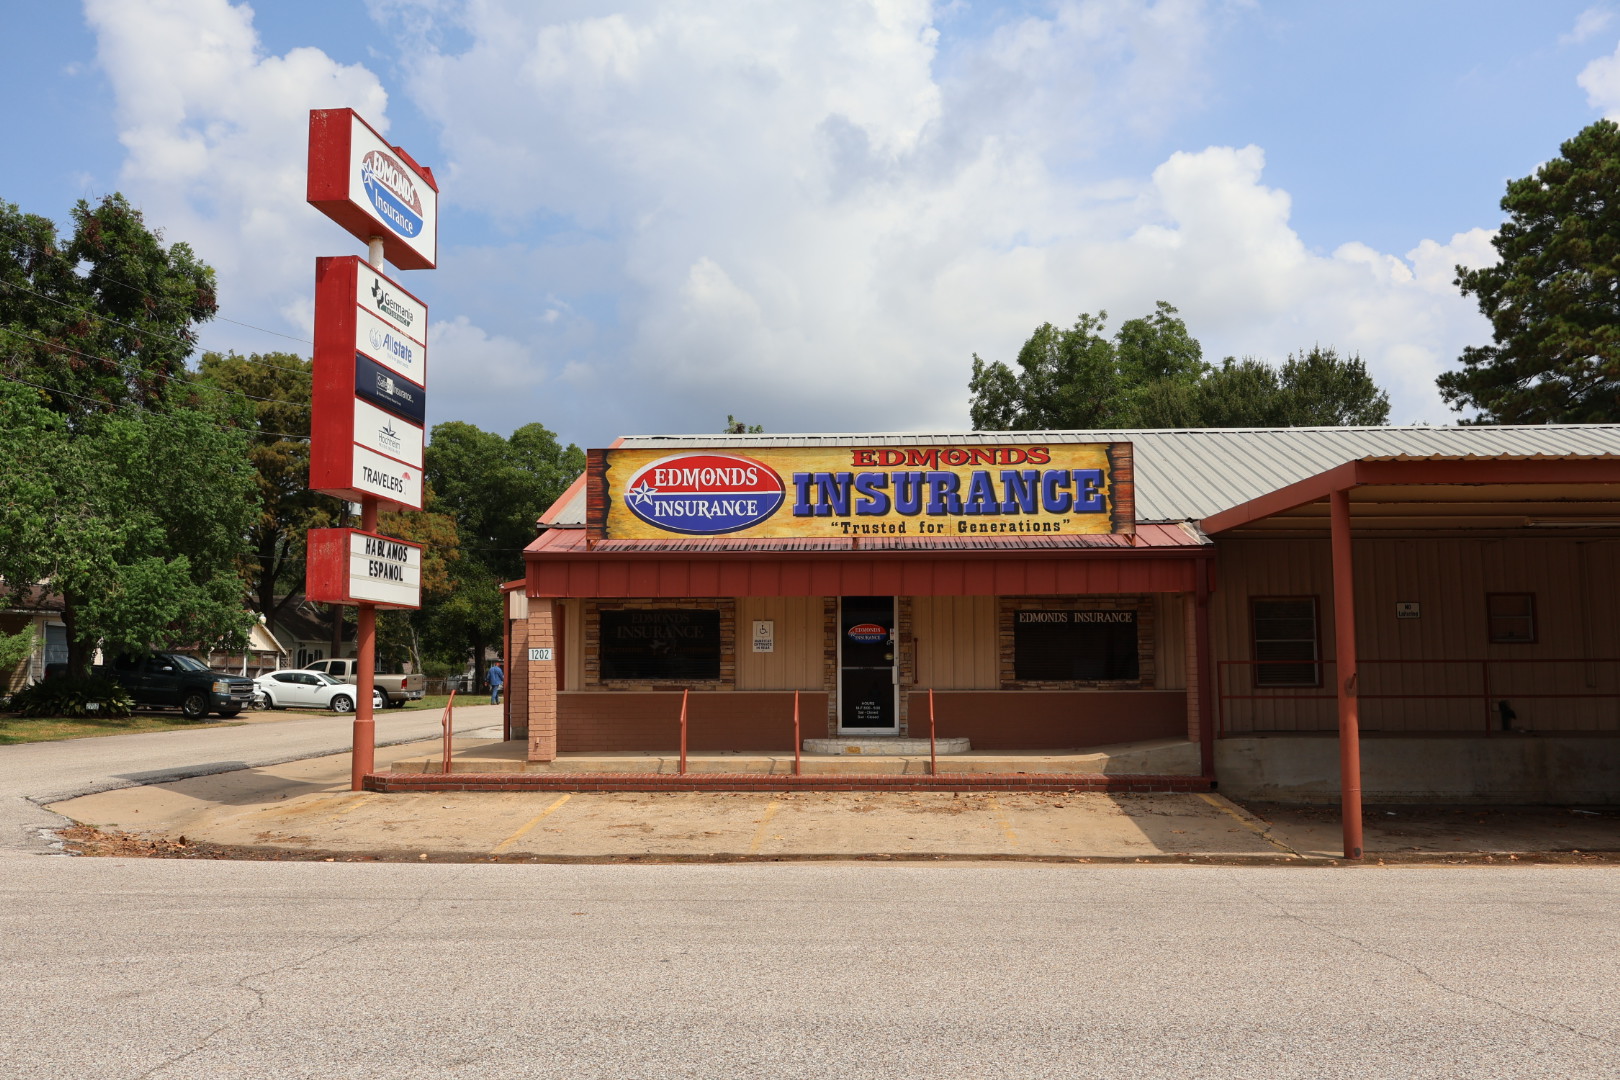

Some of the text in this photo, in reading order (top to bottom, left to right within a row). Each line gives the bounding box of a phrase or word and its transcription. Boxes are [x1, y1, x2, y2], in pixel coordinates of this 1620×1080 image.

[373, 151, 415, 206] EDMONDS
[375, 188, 414, 235] Insurance
[384, 292, 414, 322] Germania
[382, 333, 412, 363] Allstate
[850, 447, 1051, 470] EDMONDS
[363, 466, 403, 493] TRAVELERS
[654, 467, 758, 491] EDMONDS
[792, 468, 1107, 517] INSURANCE
[654, 499, 758, 519] INSURANCE
[919, 521, 944, 534] for
[365, 537, 408, 562] HABLAMOS
[369, 560, 403, 581] ESPANOL
[632, 613, 690, 624] EDMONDS
[1019, 612, 1133, 623] EDMONDS INSURANCE
[617, 625, 704, 639] INSURANCE
[531, 649, 549, 660] 1202
